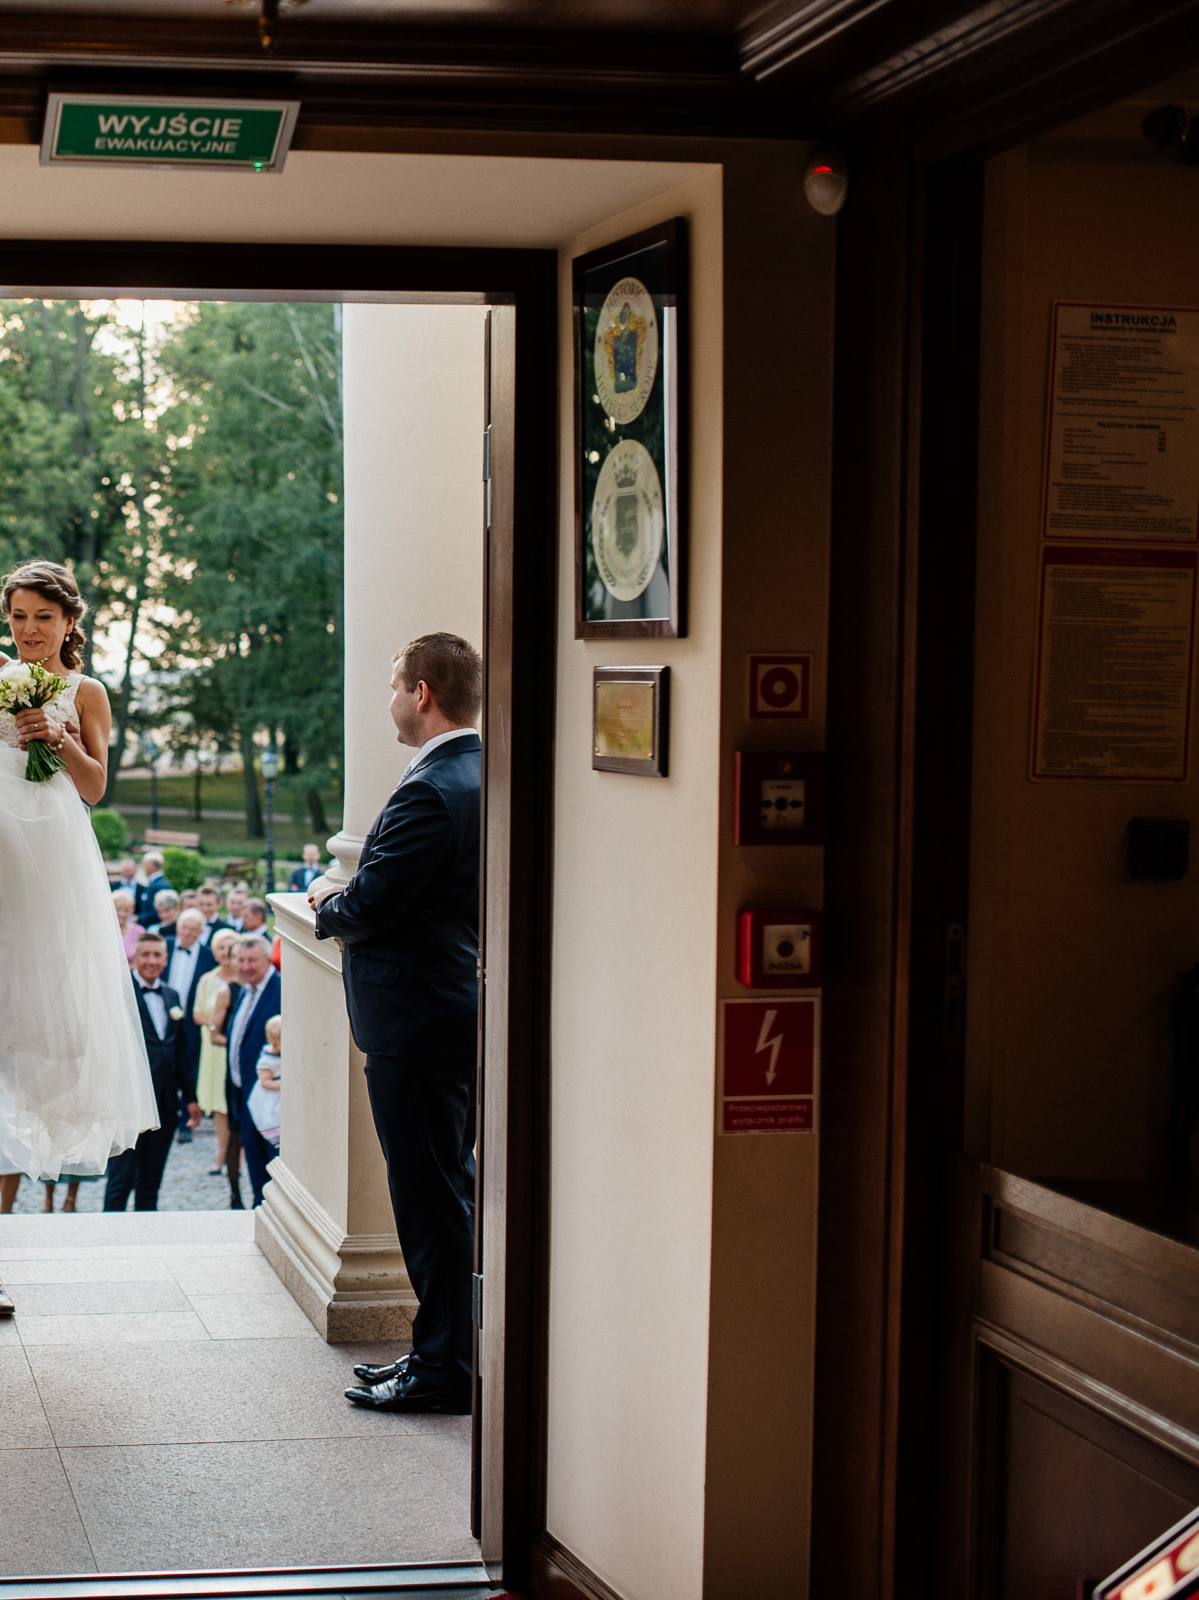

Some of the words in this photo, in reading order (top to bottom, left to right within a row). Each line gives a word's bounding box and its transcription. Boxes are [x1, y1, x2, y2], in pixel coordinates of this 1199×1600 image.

[97, 112, 243, 138] WYJŚCIE
[94, 137, 236, 154] EWAKUACYJNE
[1090, 312, 1177, 327] INSTRUKCJA
